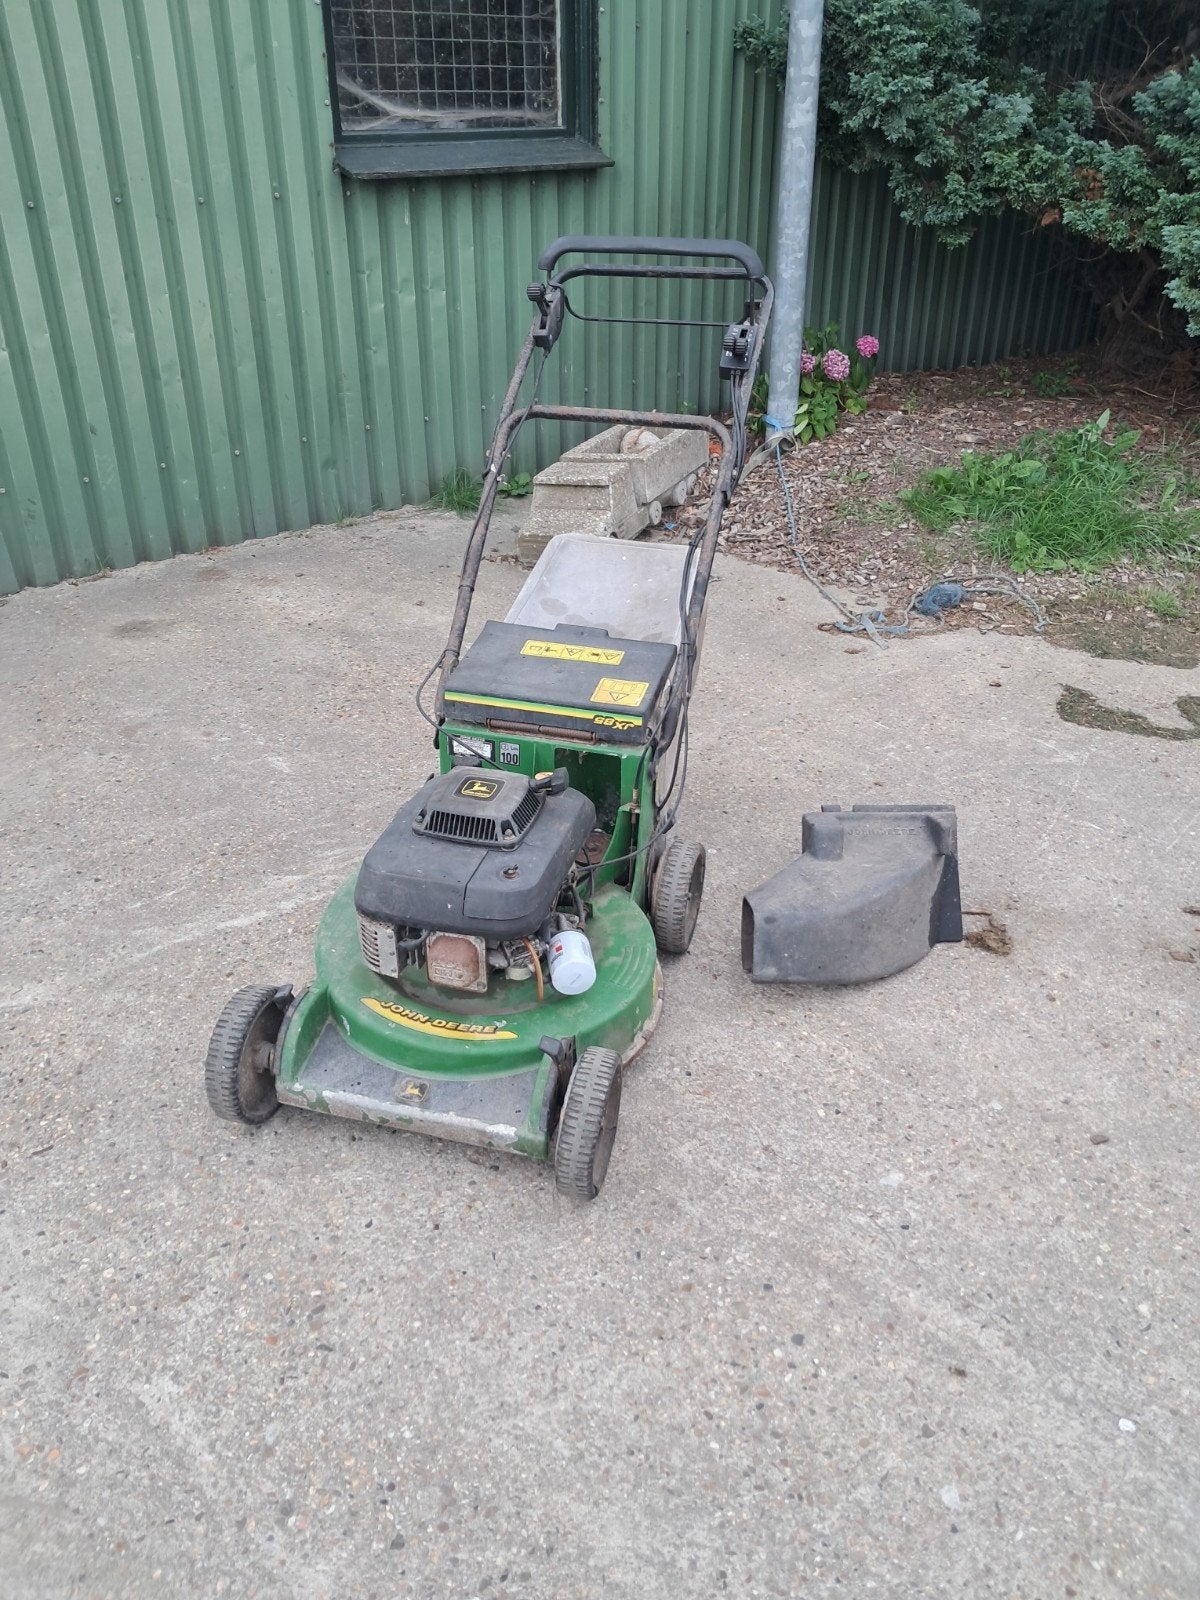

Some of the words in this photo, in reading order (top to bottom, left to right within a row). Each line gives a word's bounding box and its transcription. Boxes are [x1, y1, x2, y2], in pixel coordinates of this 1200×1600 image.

[501, 752, 519, 765] 100
[380, 1001, 430, 1023] JOHN
[431, 1018, 499, 1034] DEERE
